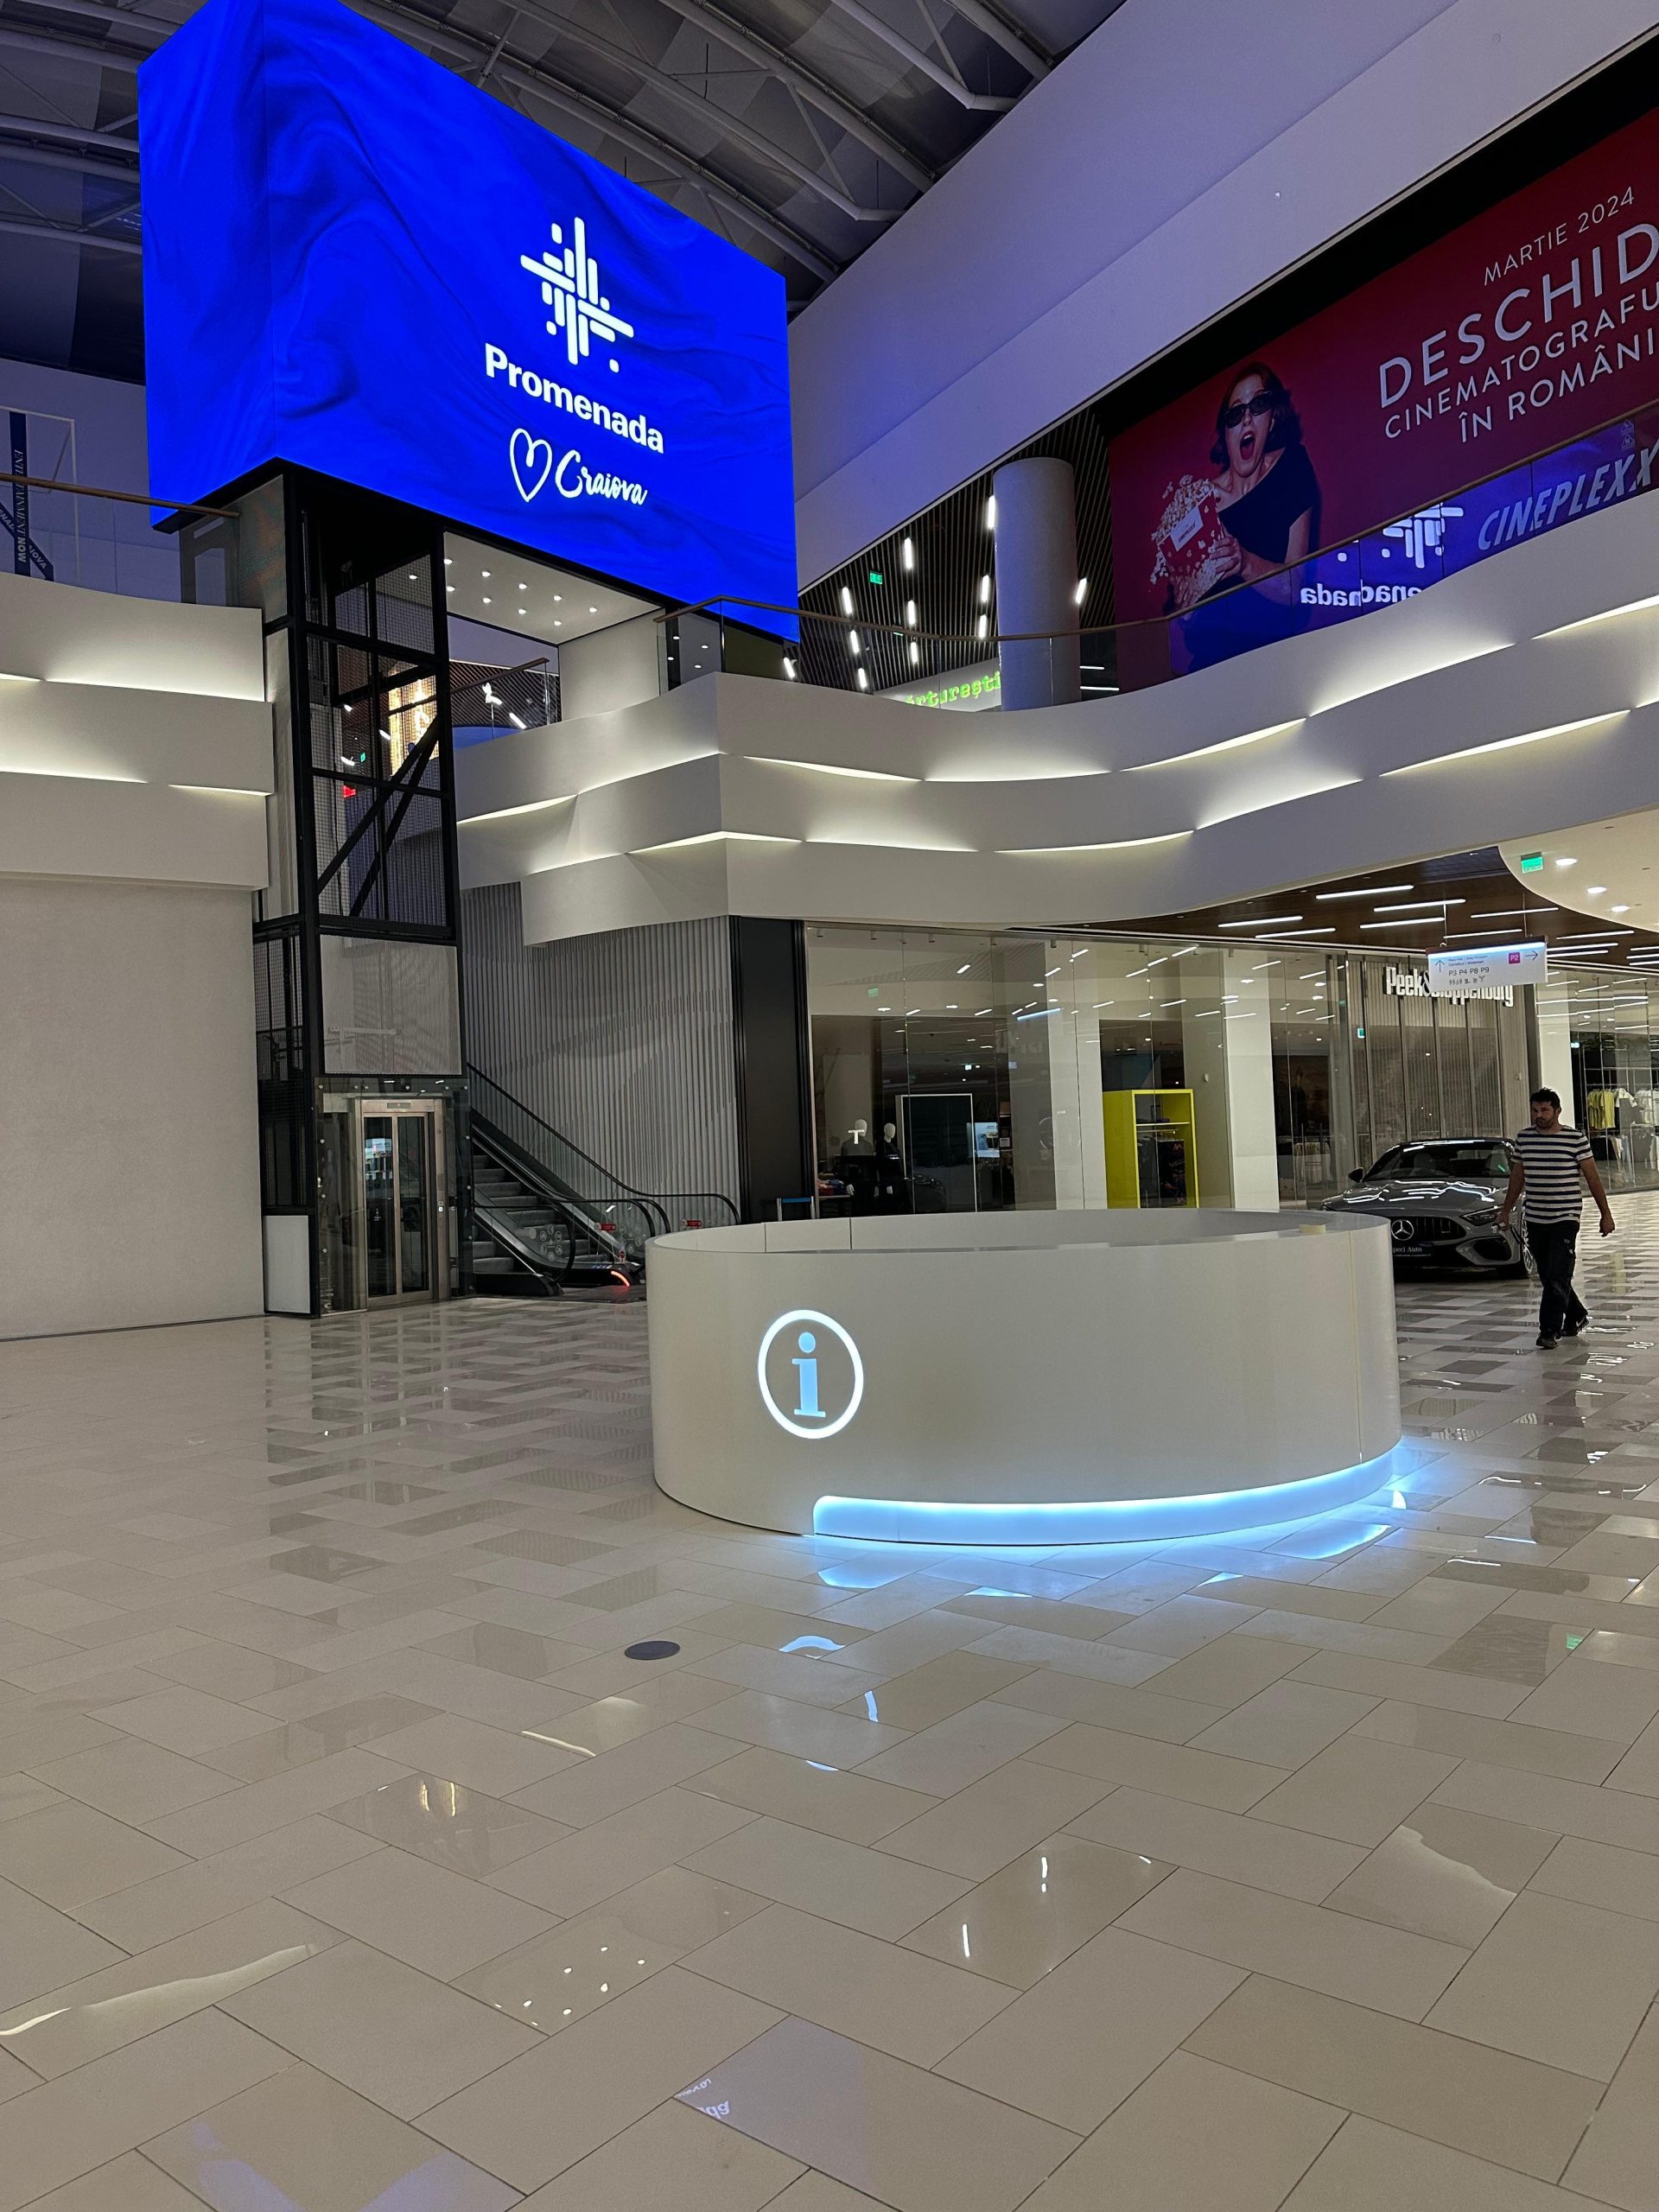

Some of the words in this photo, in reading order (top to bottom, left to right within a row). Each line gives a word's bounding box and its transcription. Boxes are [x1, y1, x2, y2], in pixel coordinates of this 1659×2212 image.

[1484, 223, 1568, 287] MARTIE
[1578, 186, 1636, 234] 2024
[1379, 223, 1659, 409] DESCHID
[485, 342, 664, 454] Promenada
[1459, 406, 1492, 443] ÎN
[1507, 327, 1655, 421] ROMÂNI
[555, 449, 648, 505] Craiova
[17, 537, 27, 562] NOW
[1510, 953, 1520, 962] P2
